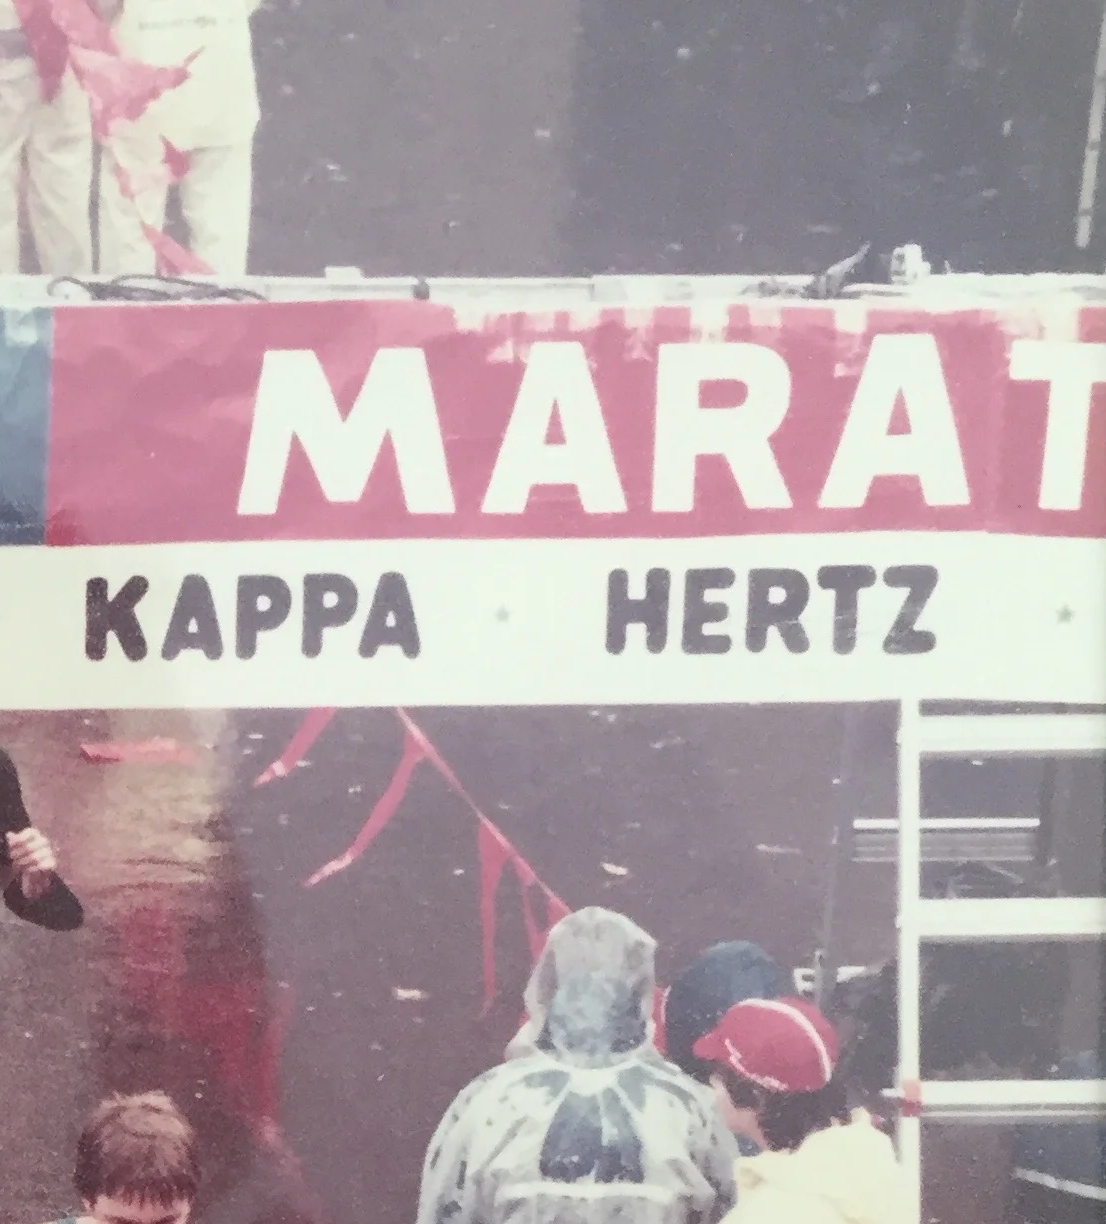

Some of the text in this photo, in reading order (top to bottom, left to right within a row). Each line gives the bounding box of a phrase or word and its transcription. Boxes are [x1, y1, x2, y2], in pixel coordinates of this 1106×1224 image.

[237, 332, 1106, 516] MARAT
[85, 572, 420, 662] KAPPA
[606, 564, 938, 655] HERTZ
